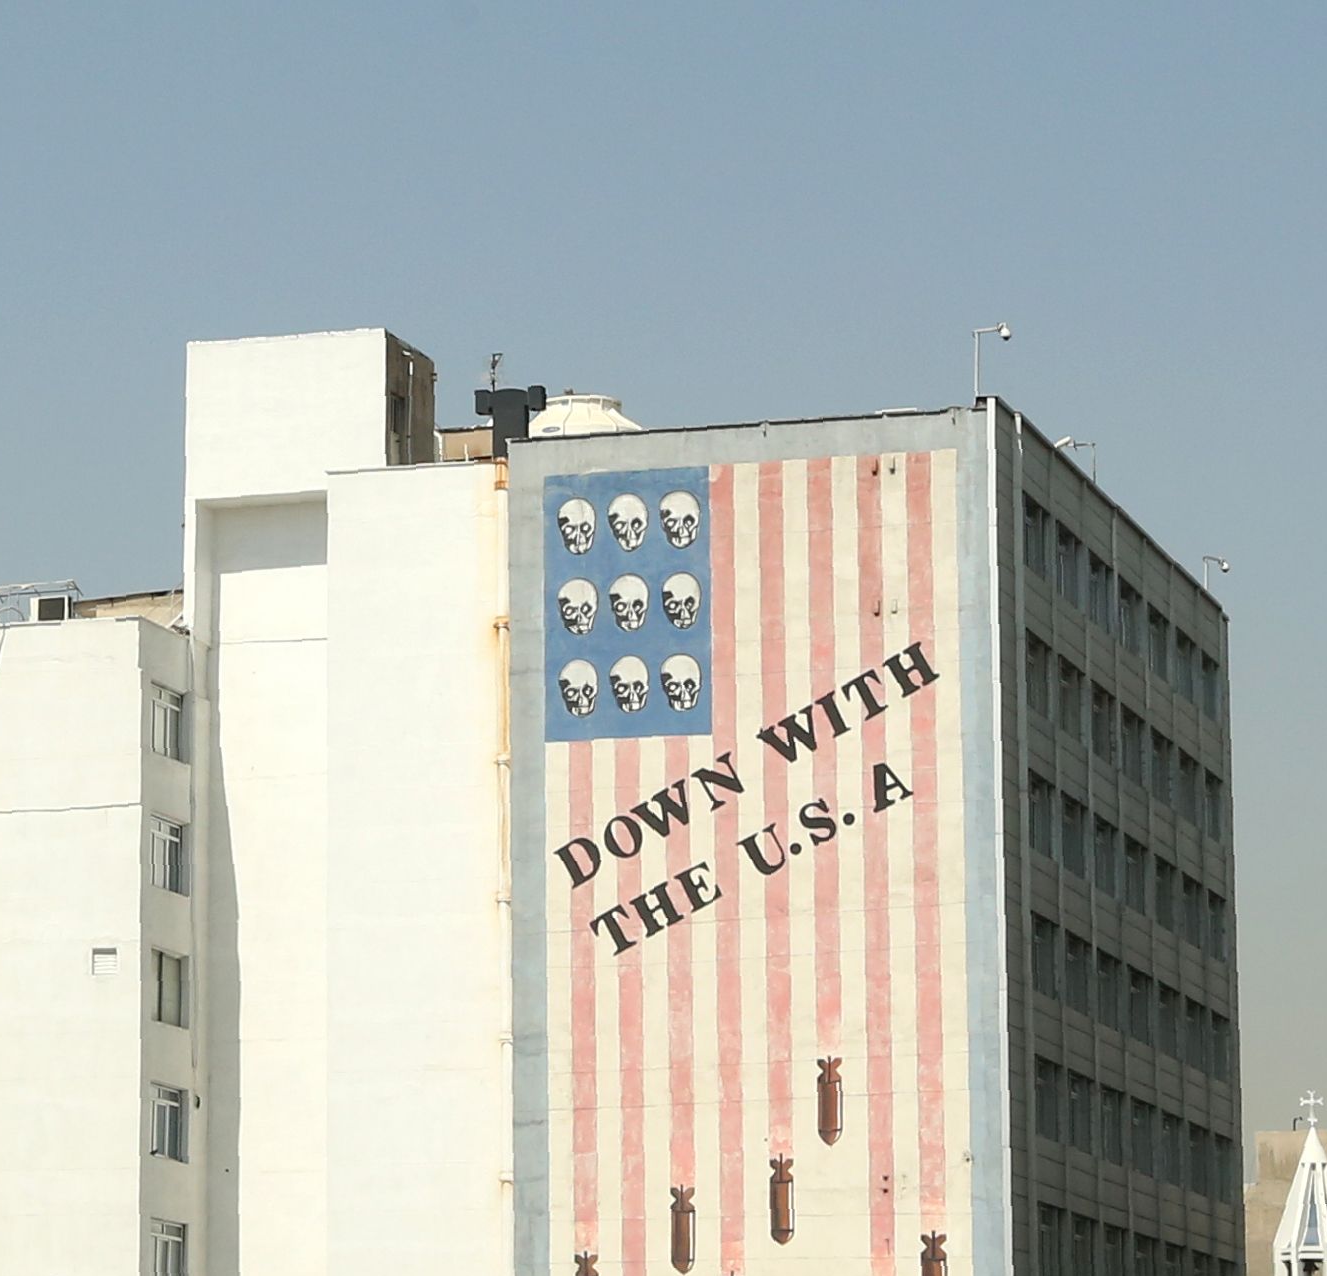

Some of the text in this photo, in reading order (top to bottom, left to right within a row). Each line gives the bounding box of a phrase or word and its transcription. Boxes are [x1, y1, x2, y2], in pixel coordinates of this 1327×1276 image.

[554, 641, 940, 889] DOWN WITH
[588, 860, 723, 957] THE
[872, 761, 914, 814] A
